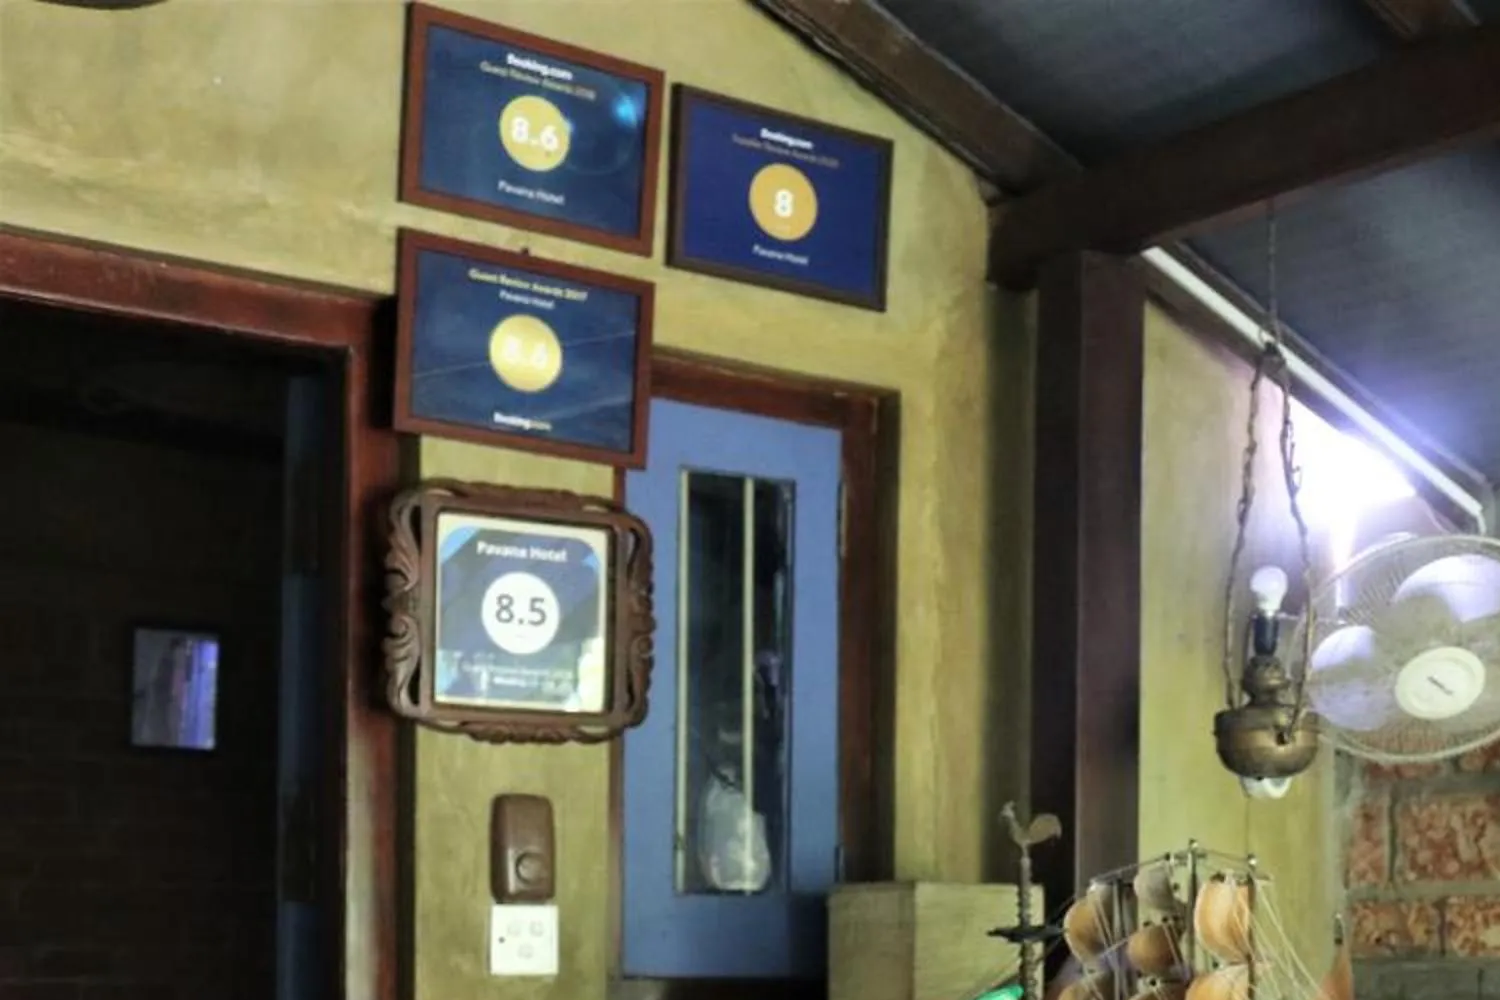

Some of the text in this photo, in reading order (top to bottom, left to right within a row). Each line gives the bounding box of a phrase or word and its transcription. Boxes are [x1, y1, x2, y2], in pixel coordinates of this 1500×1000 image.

[511, 116, 558, 151] 8.6
[774, 188, 794, 217] 8
[530, 546, 568, 562] Hotel
[496, 594, 546, 626] 8.5
